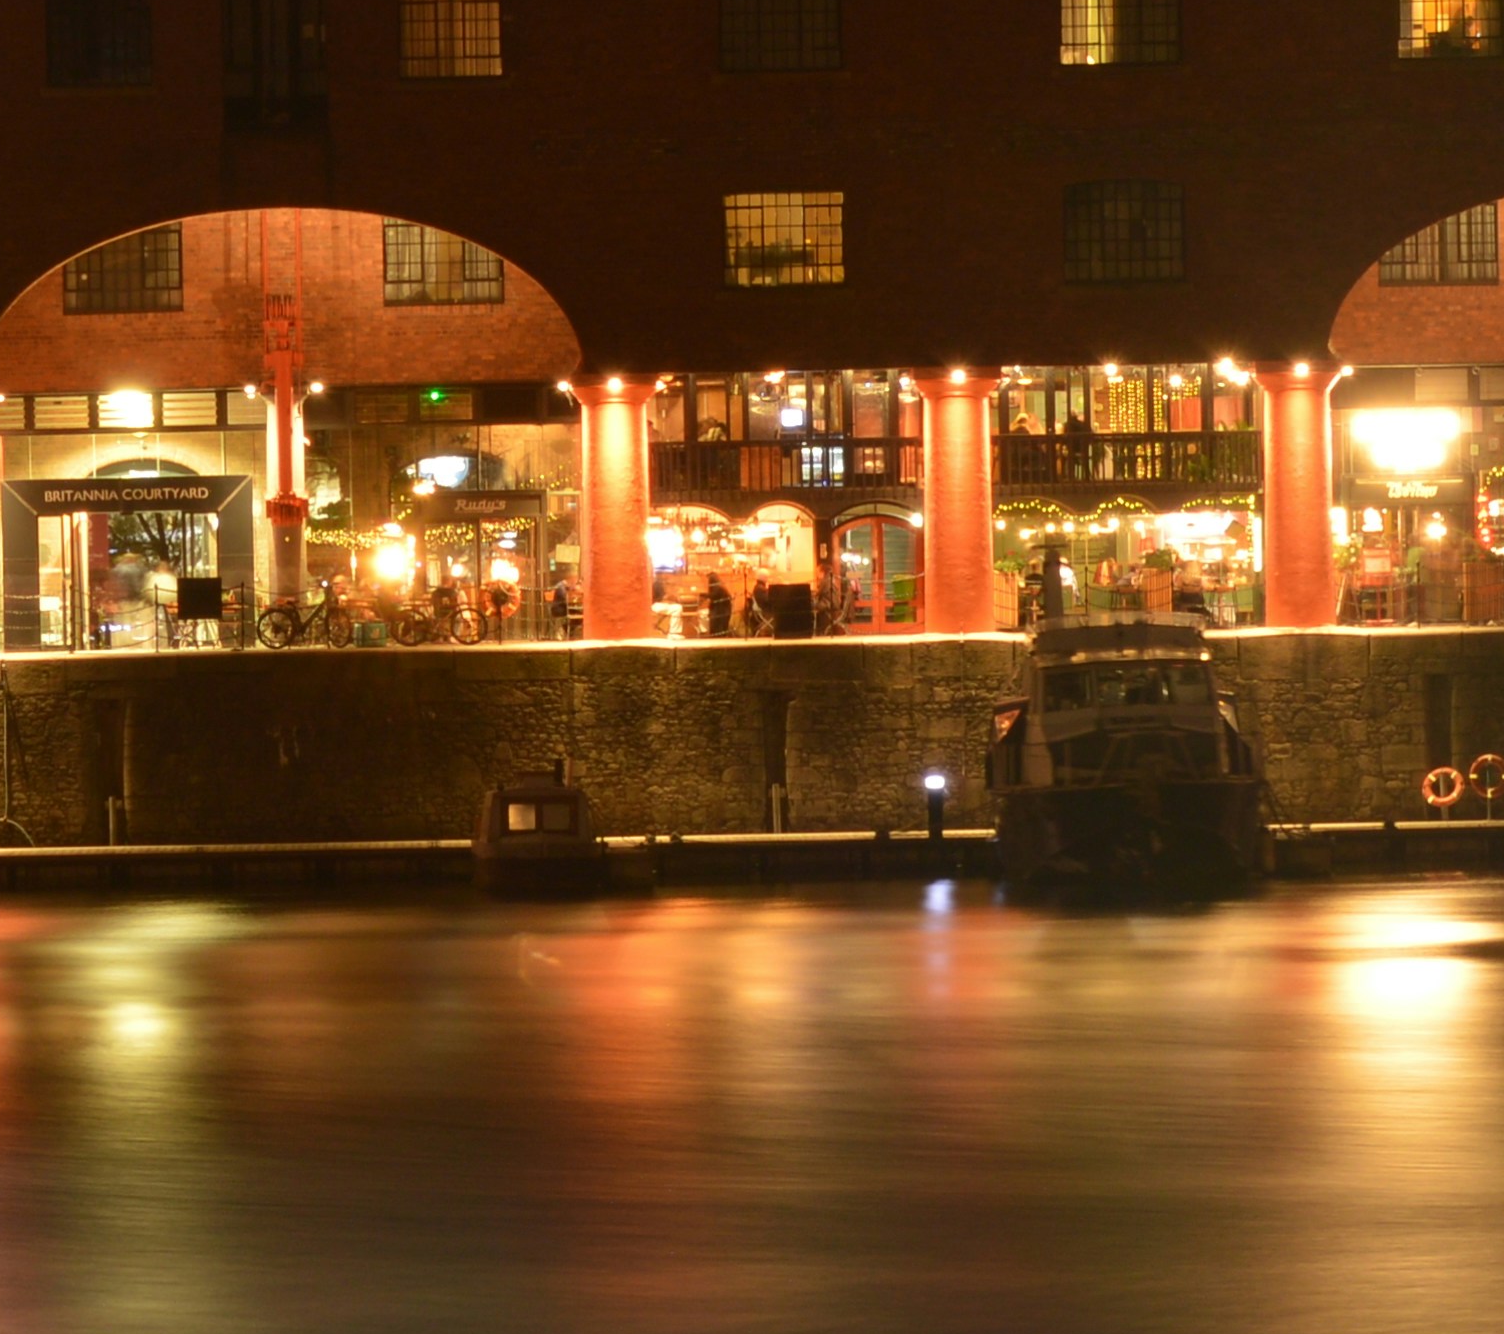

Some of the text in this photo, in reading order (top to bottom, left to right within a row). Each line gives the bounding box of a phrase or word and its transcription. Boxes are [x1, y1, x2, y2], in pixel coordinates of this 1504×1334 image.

[44, 487, 209, 503] BRITANNIA COURTYARD
[454, 499, 506, 513] Rudy's
